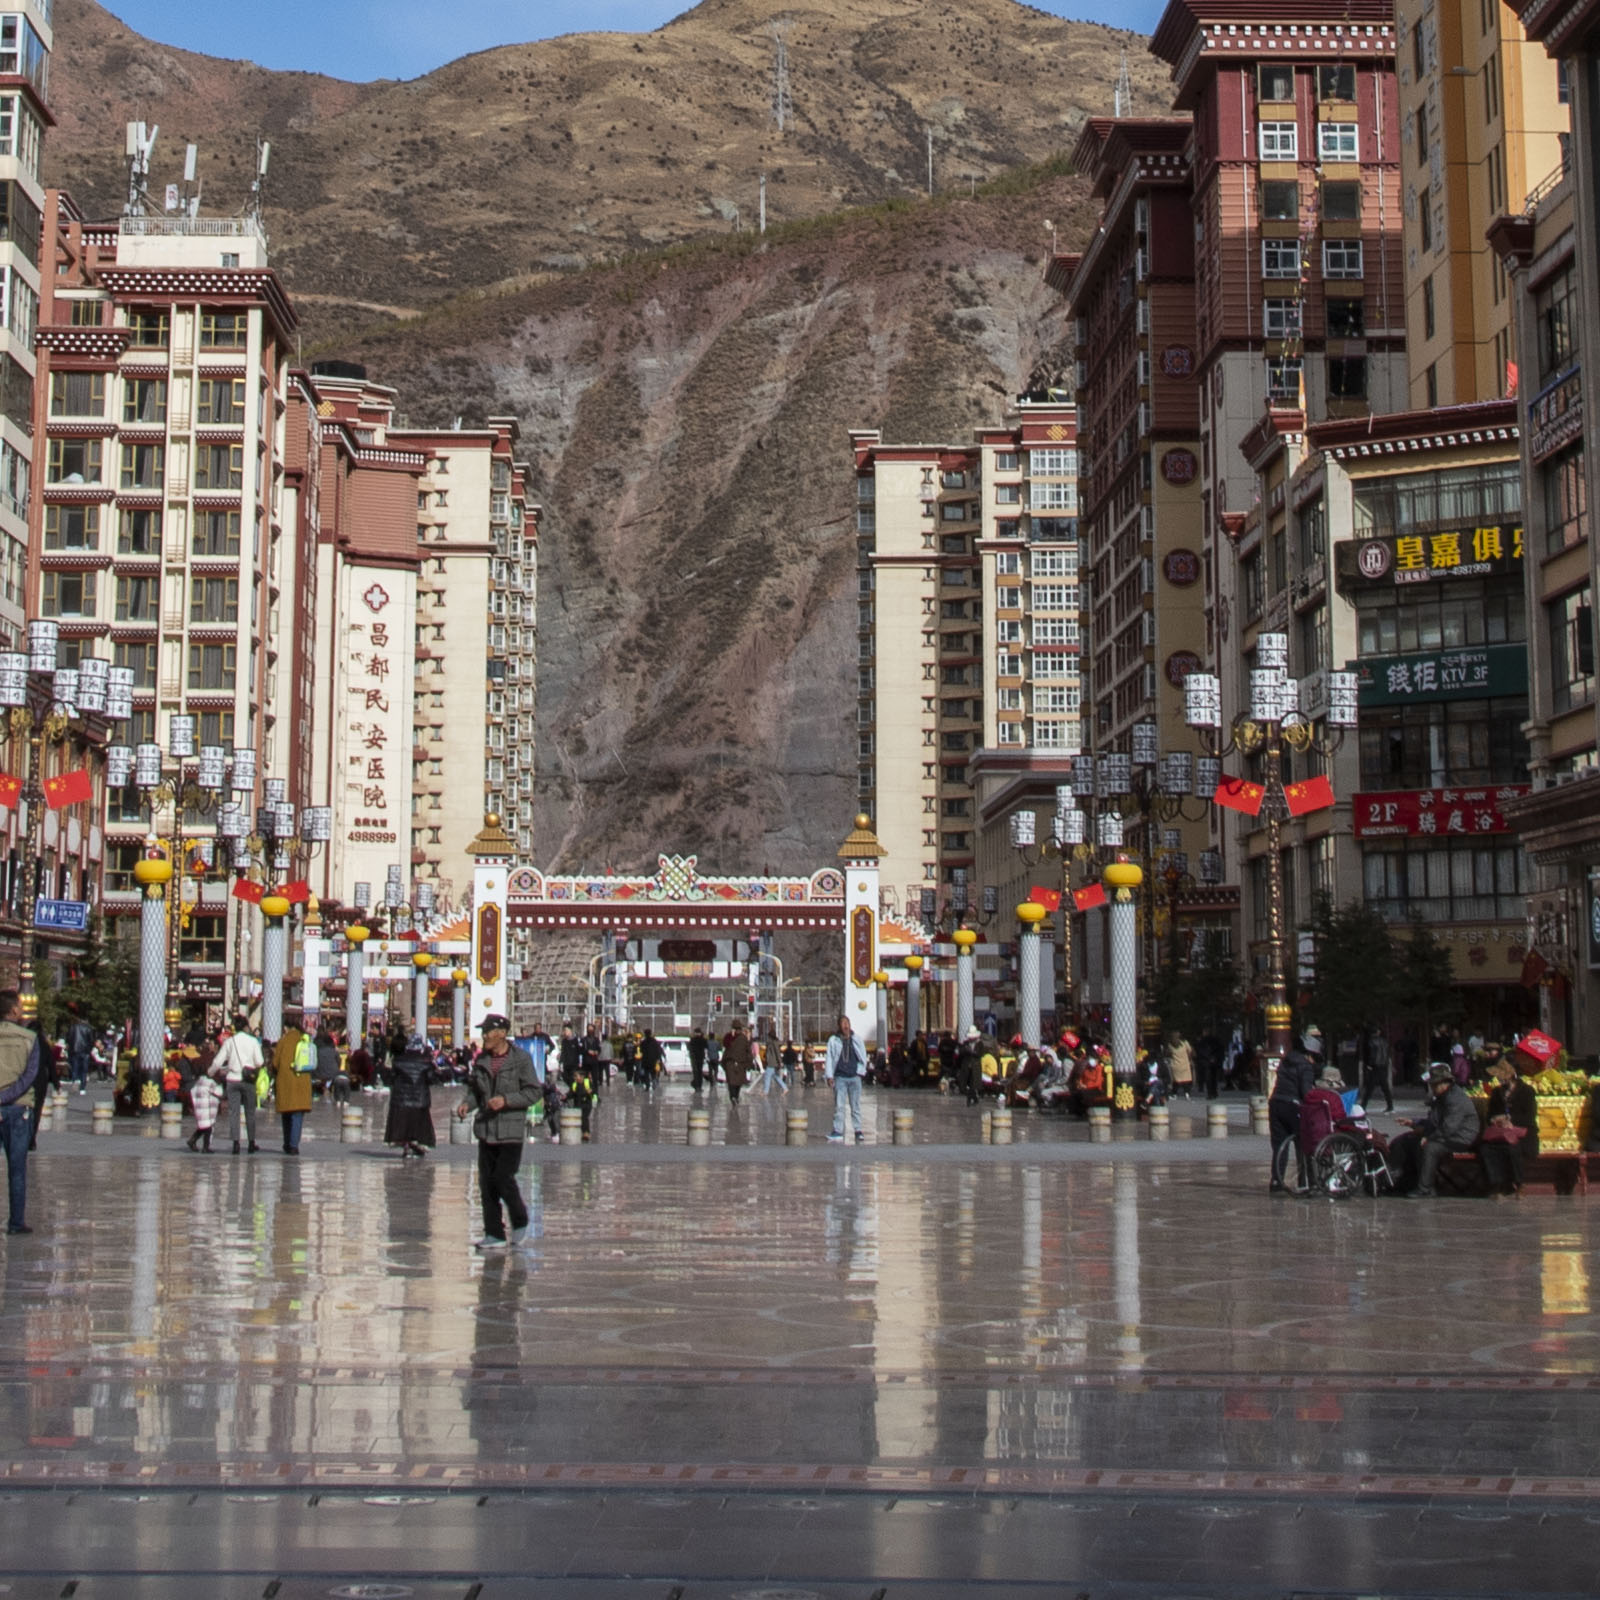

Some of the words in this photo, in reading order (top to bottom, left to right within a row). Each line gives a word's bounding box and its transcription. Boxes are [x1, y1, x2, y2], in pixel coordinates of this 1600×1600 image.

[1441, 668, 1467, 684] KTV
[1474, 665, 1489, 680] 3F
[362, 622, 390, 809] 昌都民安医院
[1369, 803, 1398, 823] 2F
[348, 831, 397, 843] 4988999
